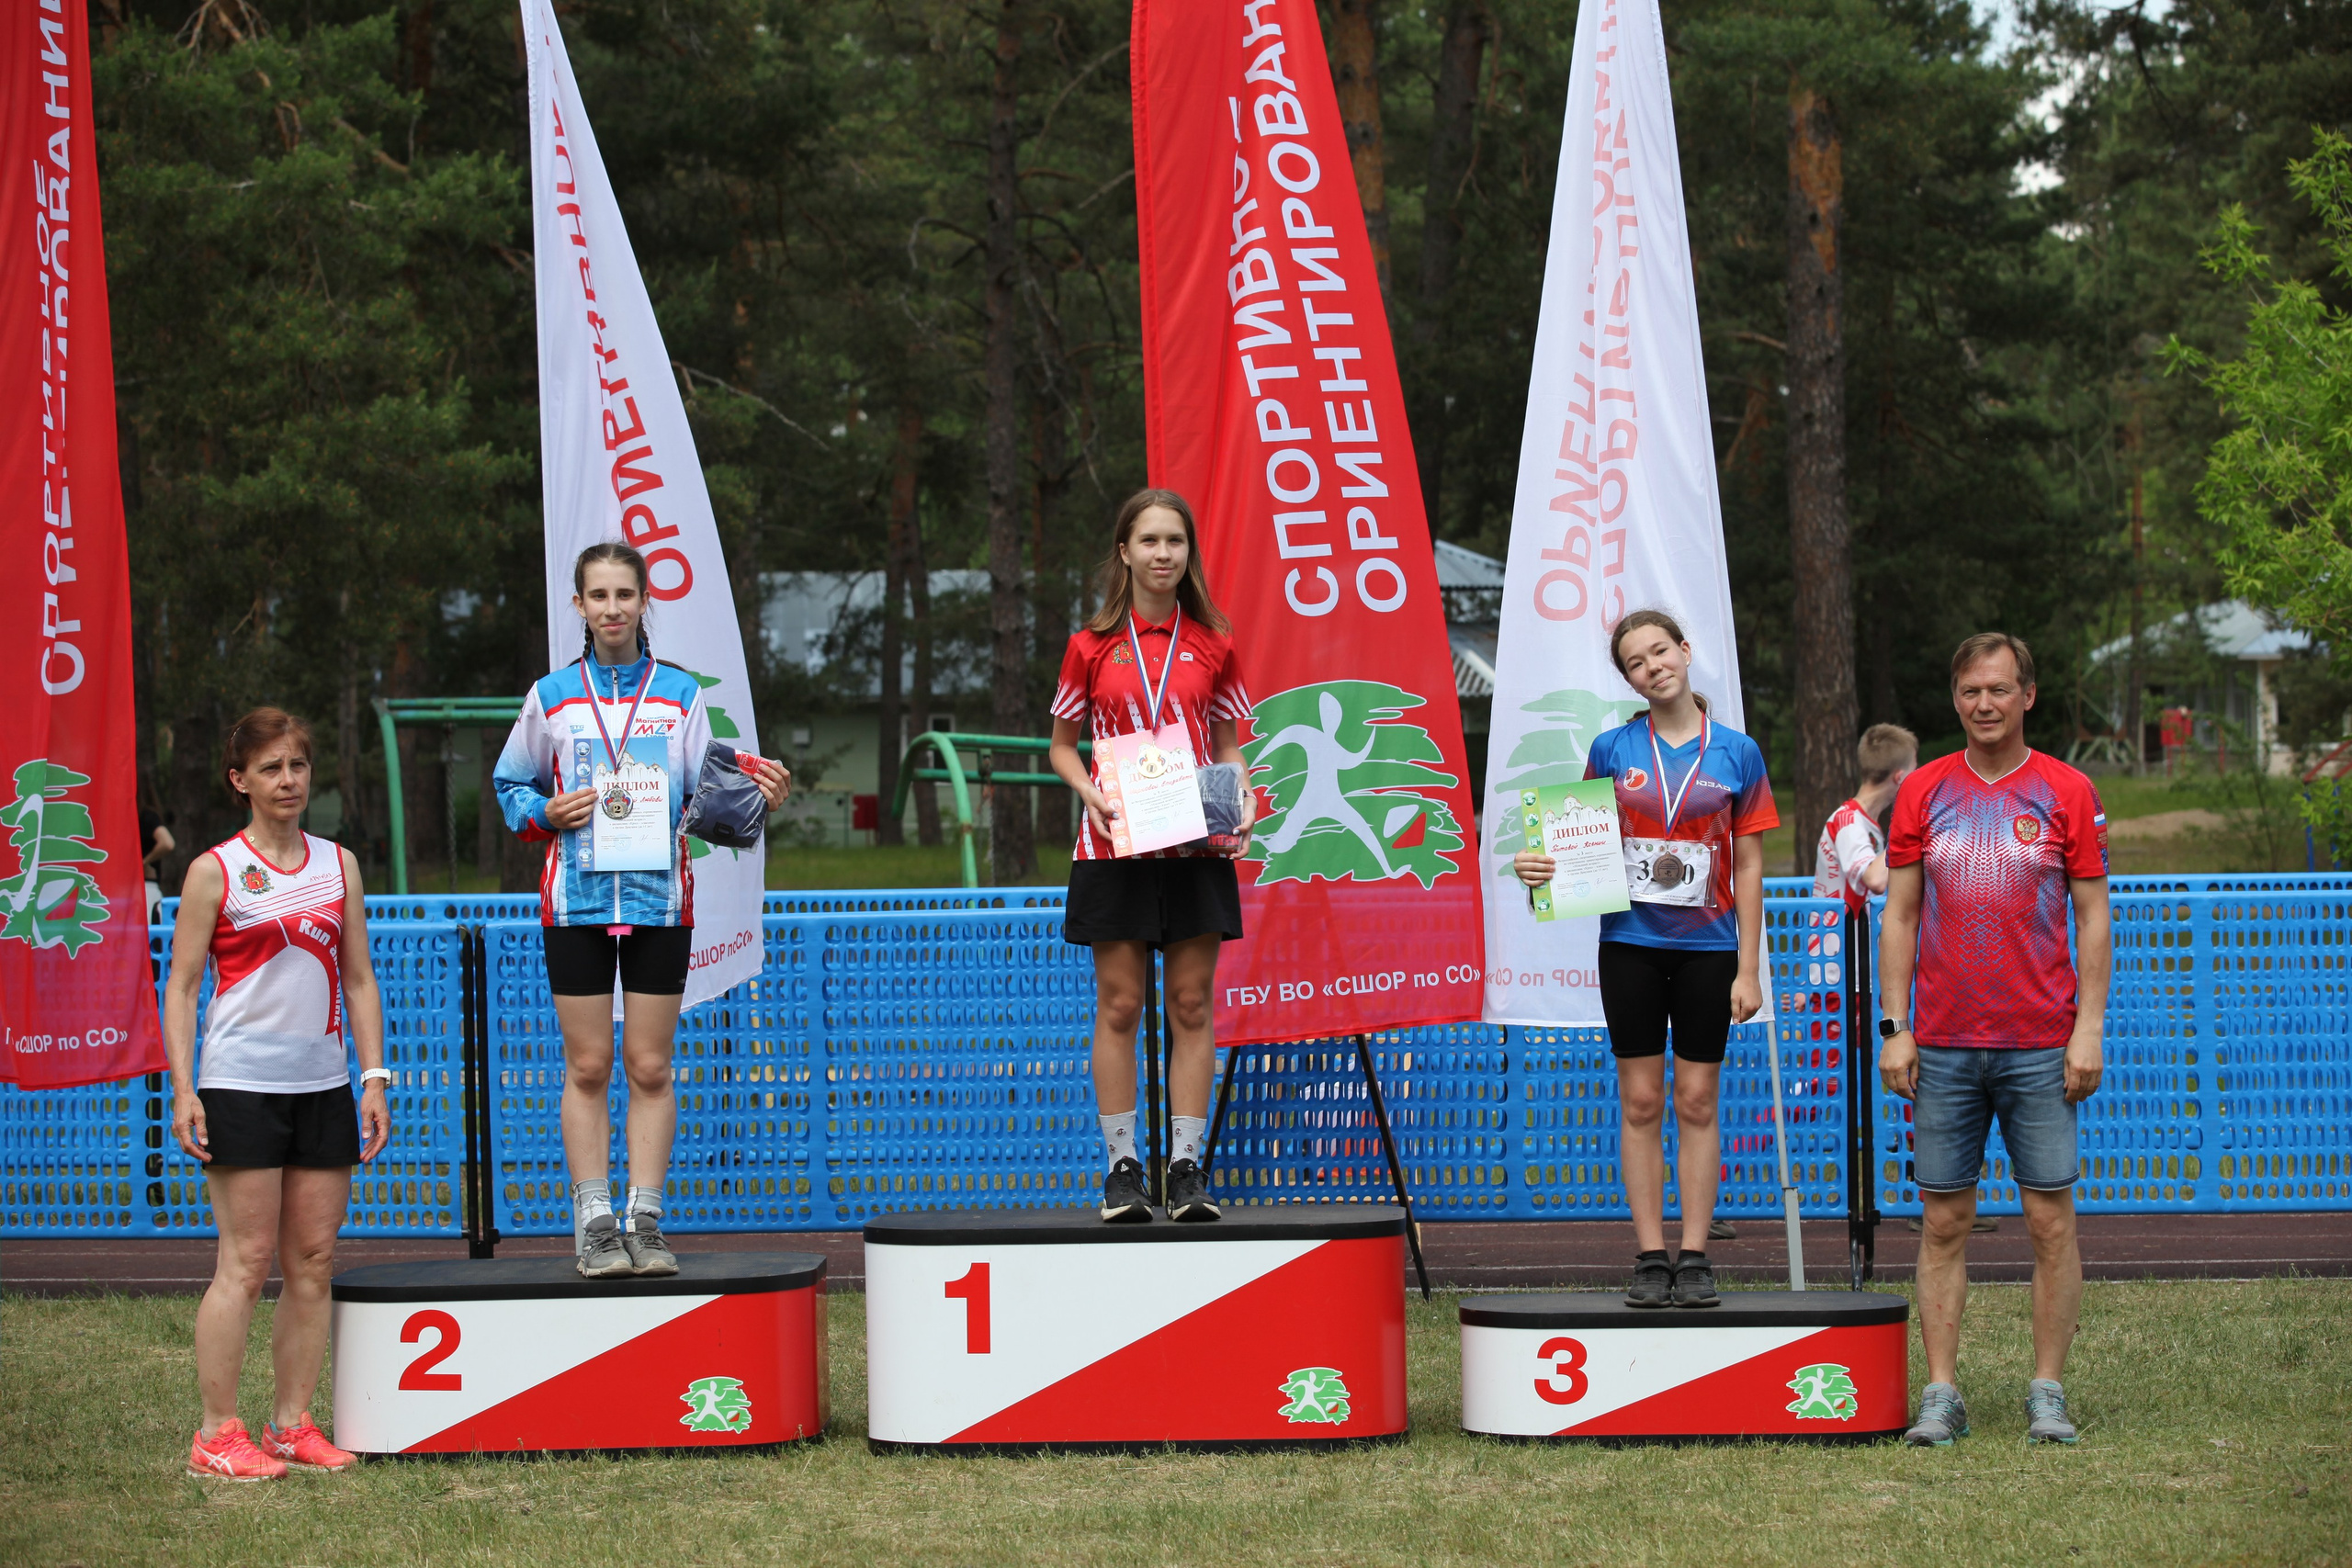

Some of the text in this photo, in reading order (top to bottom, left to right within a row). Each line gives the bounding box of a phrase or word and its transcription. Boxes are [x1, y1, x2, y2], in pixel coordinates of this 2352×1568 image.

[614, 805, 621, 814] 2
[1553, 823, 1610, 840] ДИПЛОМ
[1636, 860, 1695, 885] 30
[298, 918, 331, 947] Run
[1226, 964, 1481, 1007] ГБУ ВО «СШОР по СО»
[58, 1035, 80, 1051] по
[85, 1027, 128, 1047] СО»
[944, 1262, 991, 1354] 1
[398, 1309, 462, 1391] 2
[1533, 1337, 1589, 1405] 3
